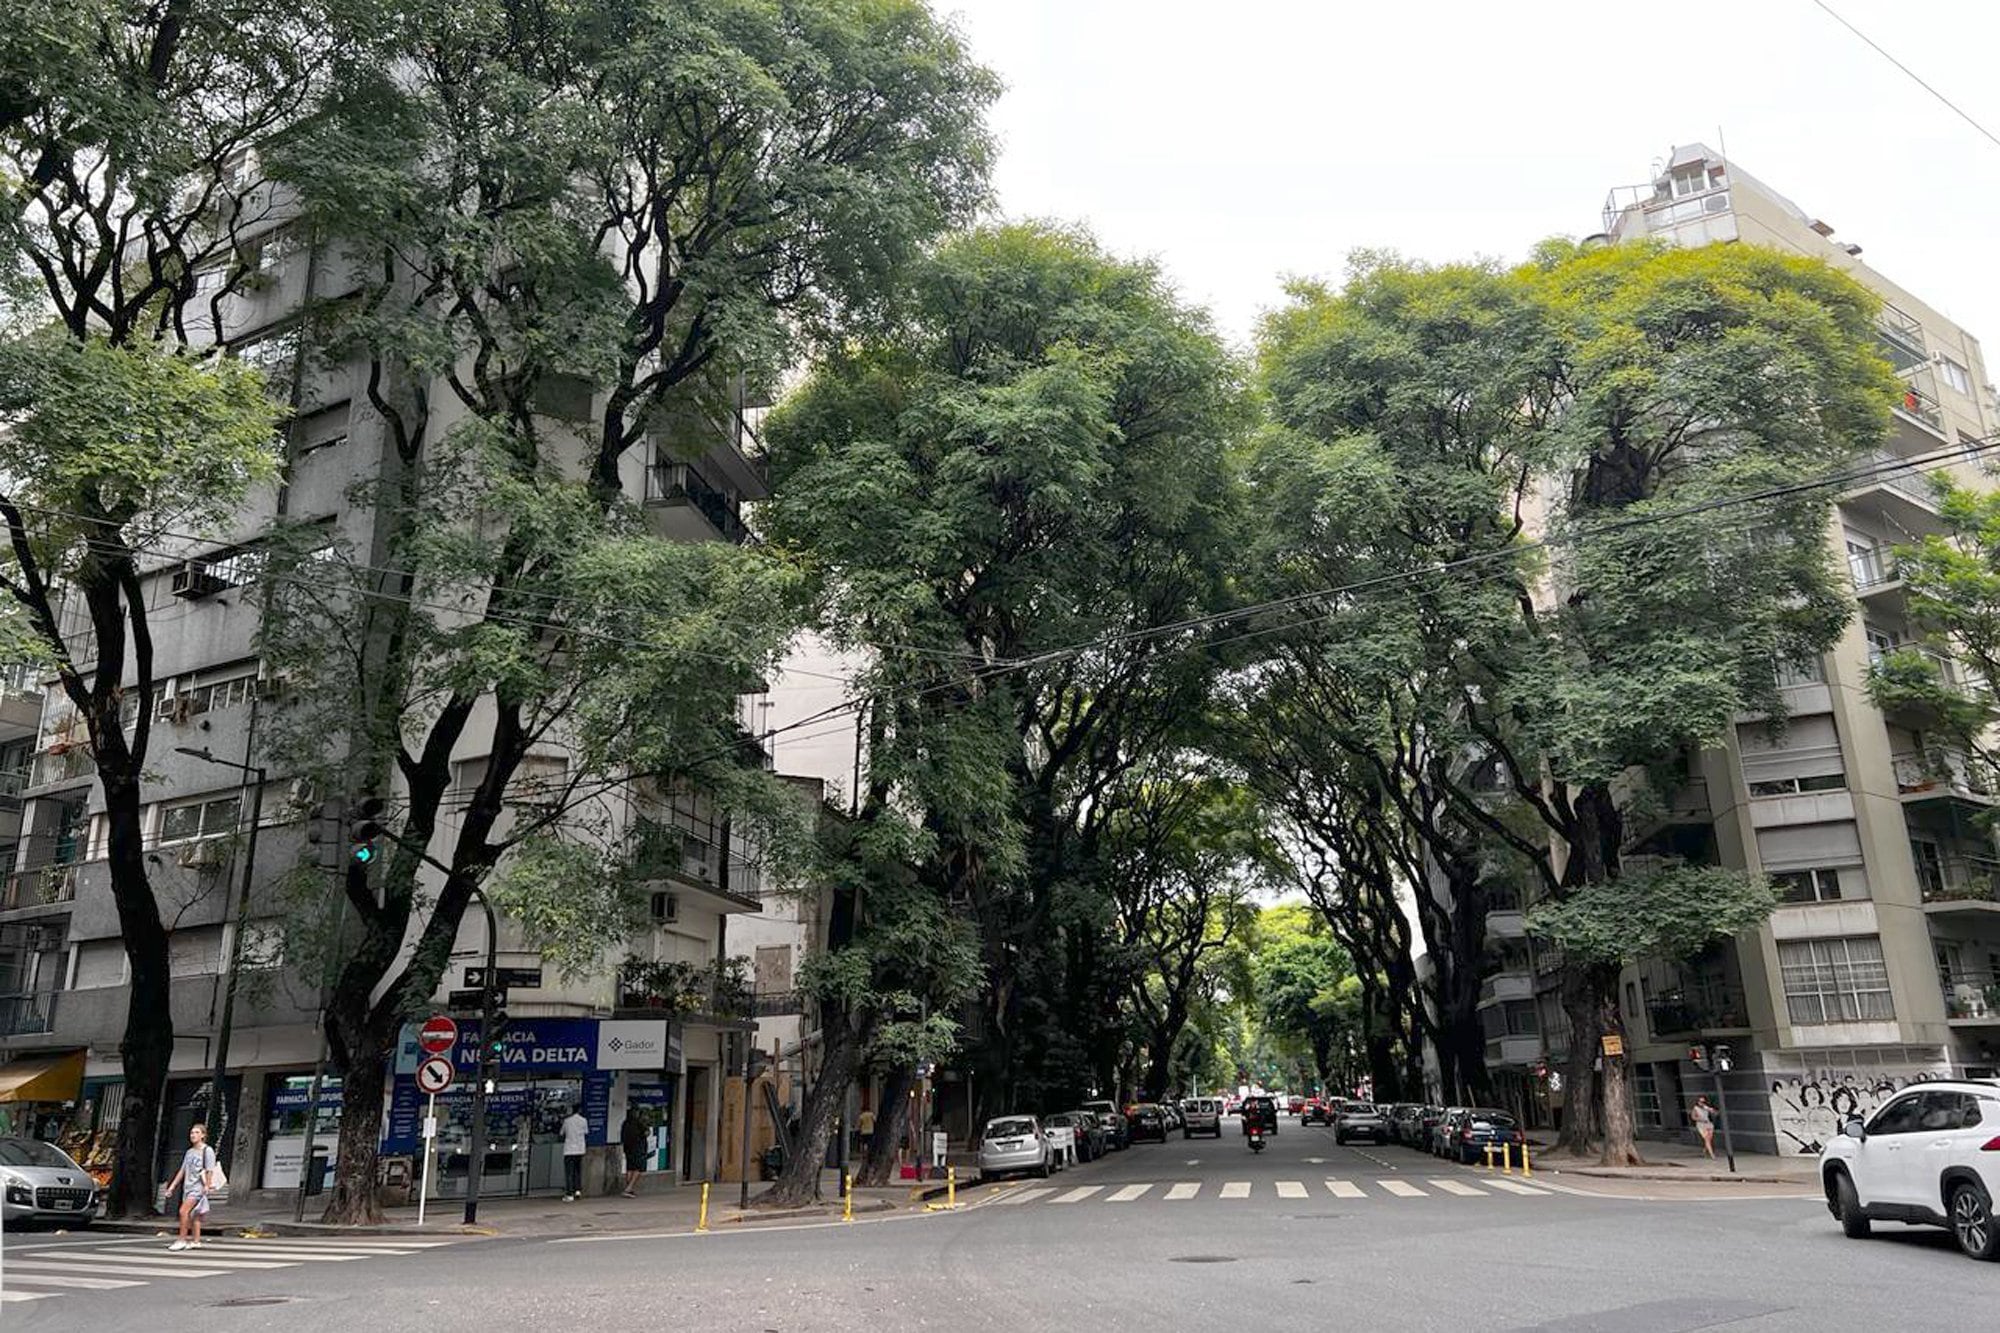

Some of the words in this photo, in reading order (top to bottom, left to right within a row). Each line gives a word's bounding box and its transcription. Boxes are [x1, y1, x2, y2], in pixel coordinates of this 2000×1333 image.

[462, 1031, 536, 1043] FAACIA
[624, 1040, 655, 1050] Gador
[532, 1046, 588, 1062] DELTA
